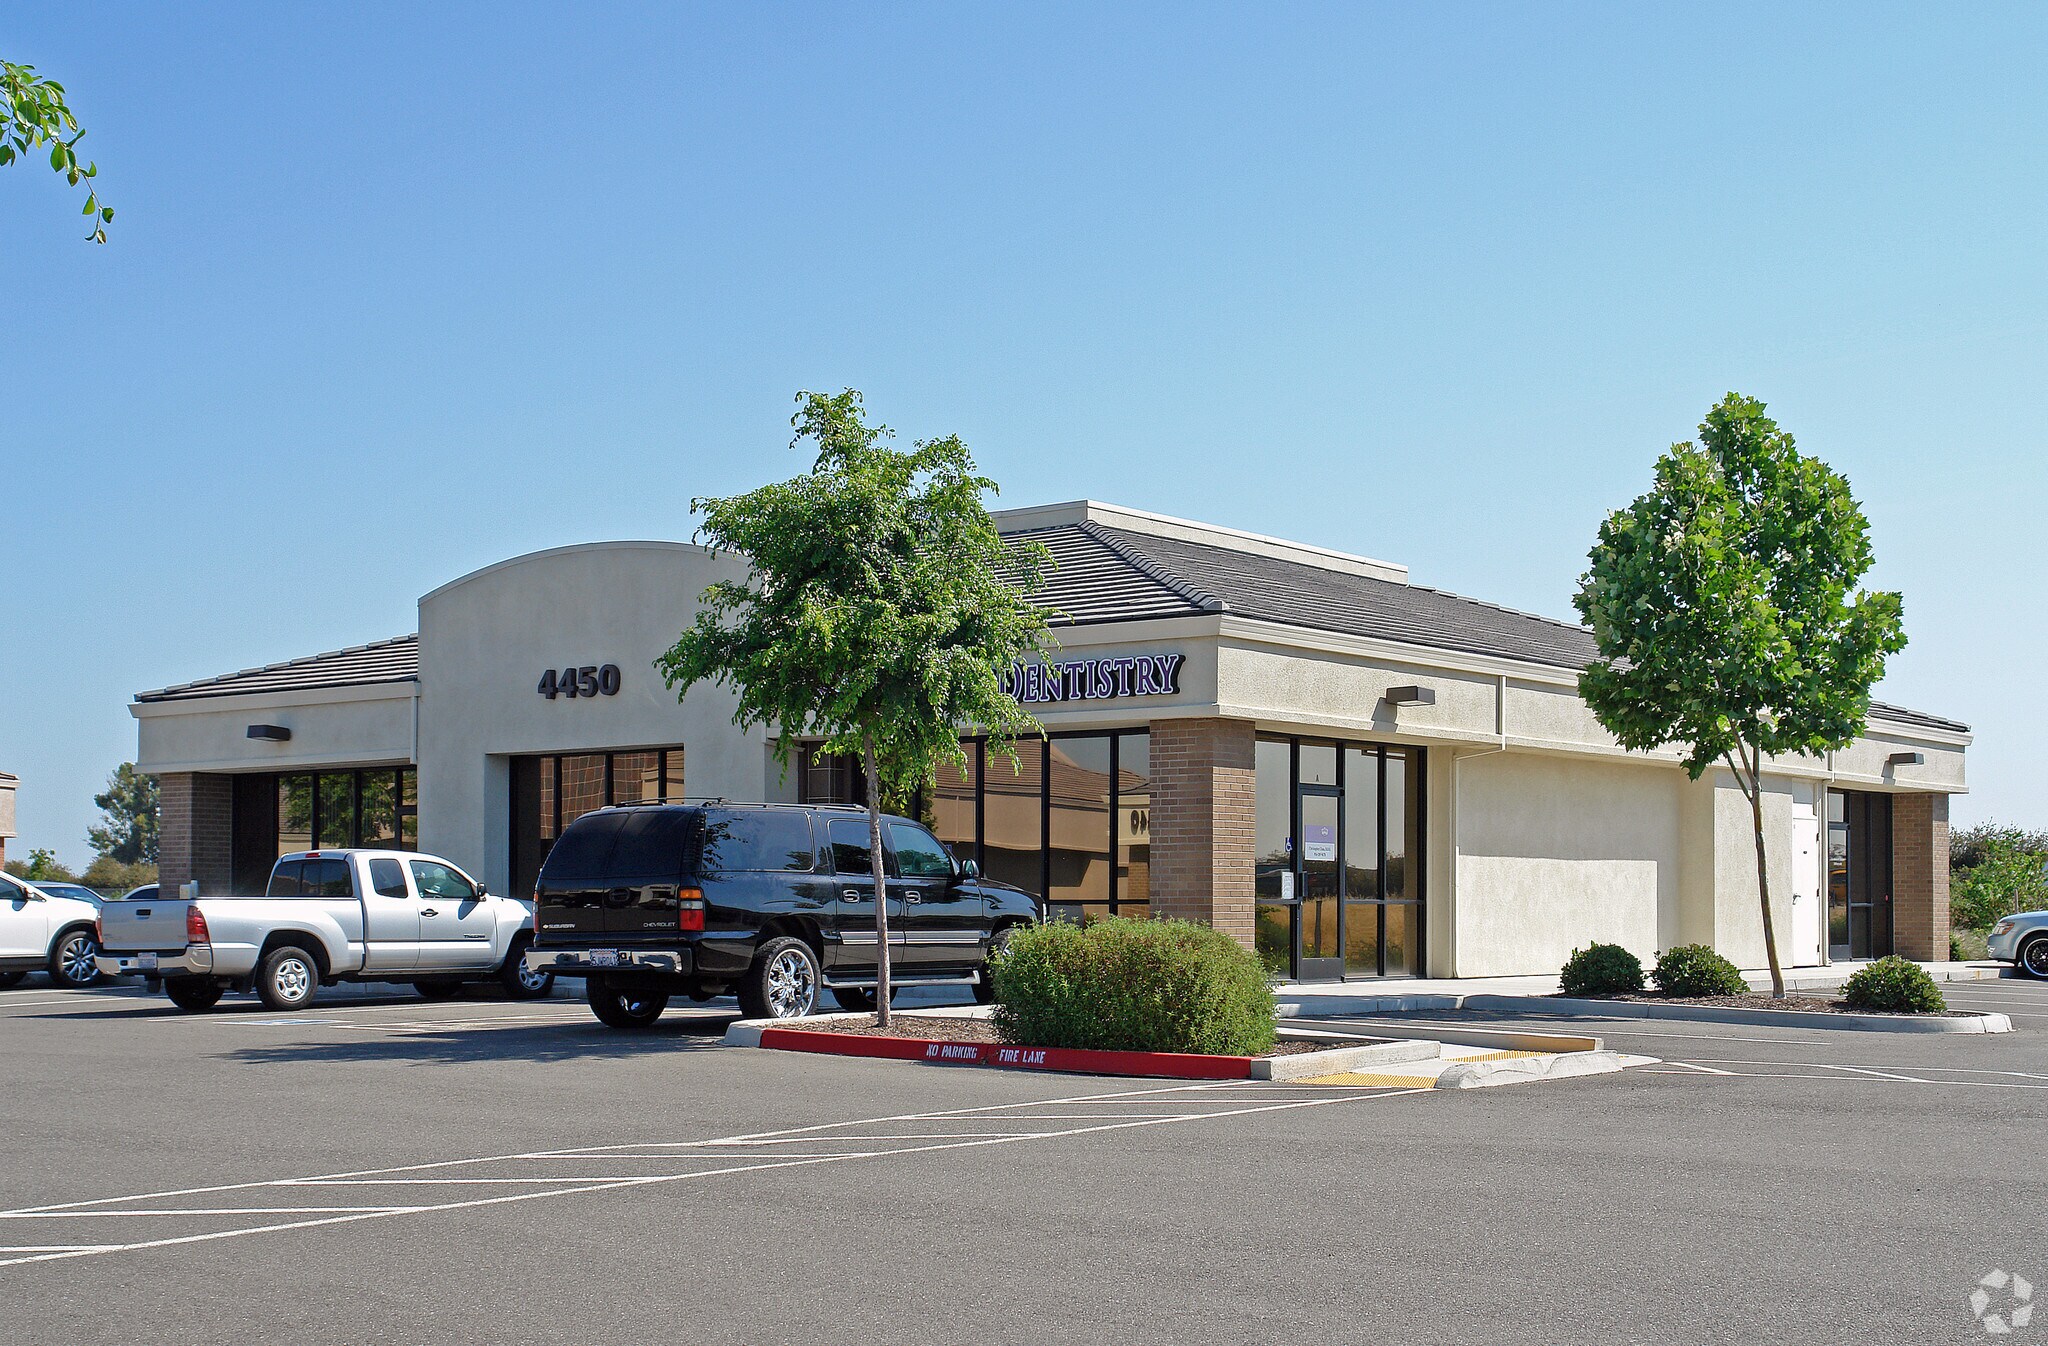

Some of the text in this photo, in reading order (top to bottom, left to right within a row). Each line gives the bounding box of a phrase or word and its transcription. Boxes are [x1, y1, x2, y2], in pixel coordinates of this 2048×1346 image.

[537, 663, 621, 700] 4450
[998, 654, 1184, 703] DENTISTRY
[926, 1043, 978, 1059] NO PARKING
[999, 1048, 1046, 1064] FIRE LANE
